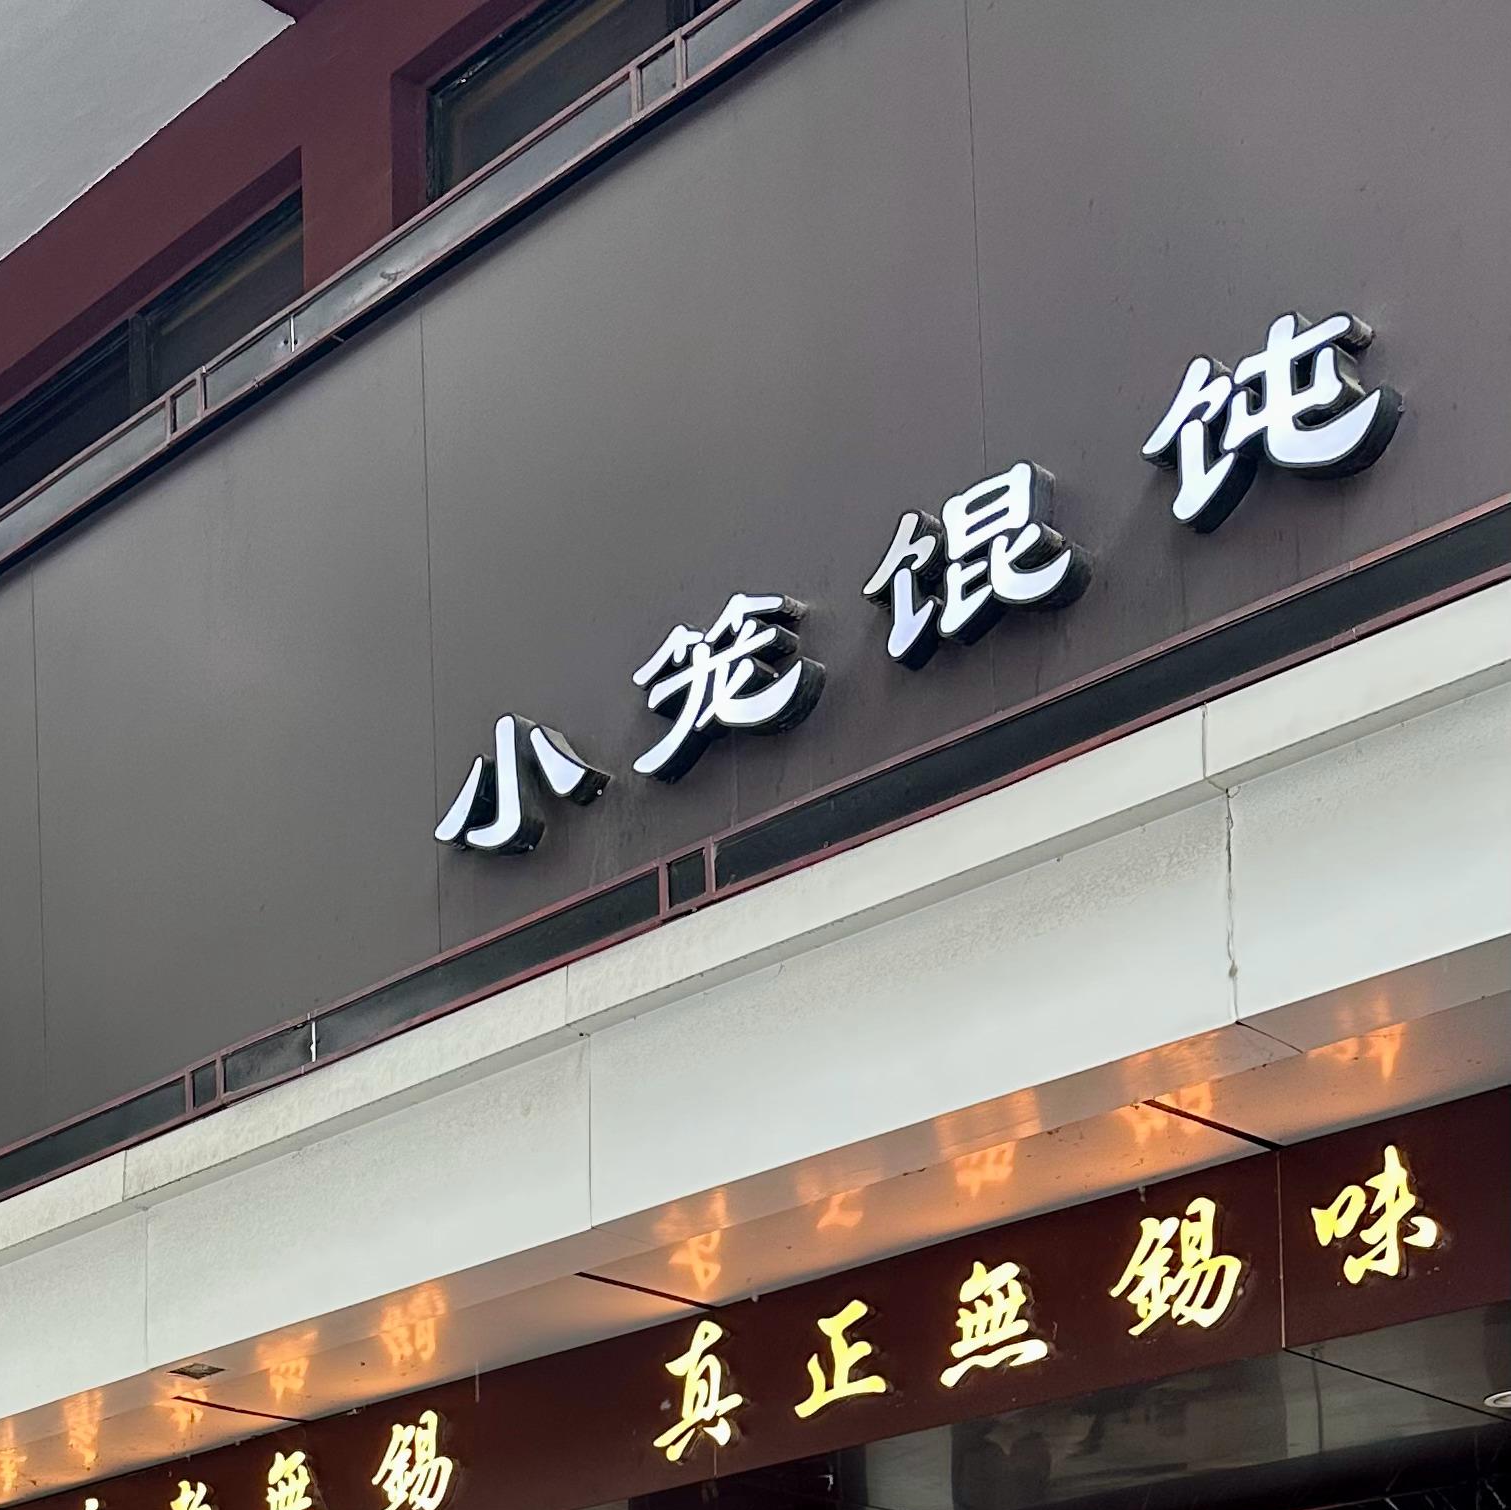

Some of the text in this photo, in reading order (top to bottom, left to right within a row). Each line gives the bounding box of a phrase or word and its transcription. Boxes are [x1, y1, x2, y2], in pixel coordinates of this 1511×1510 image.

[434, 313, 1383, 846] 小笼馄饨
[653, 1145, 1440, 1461] 真正無錫味
